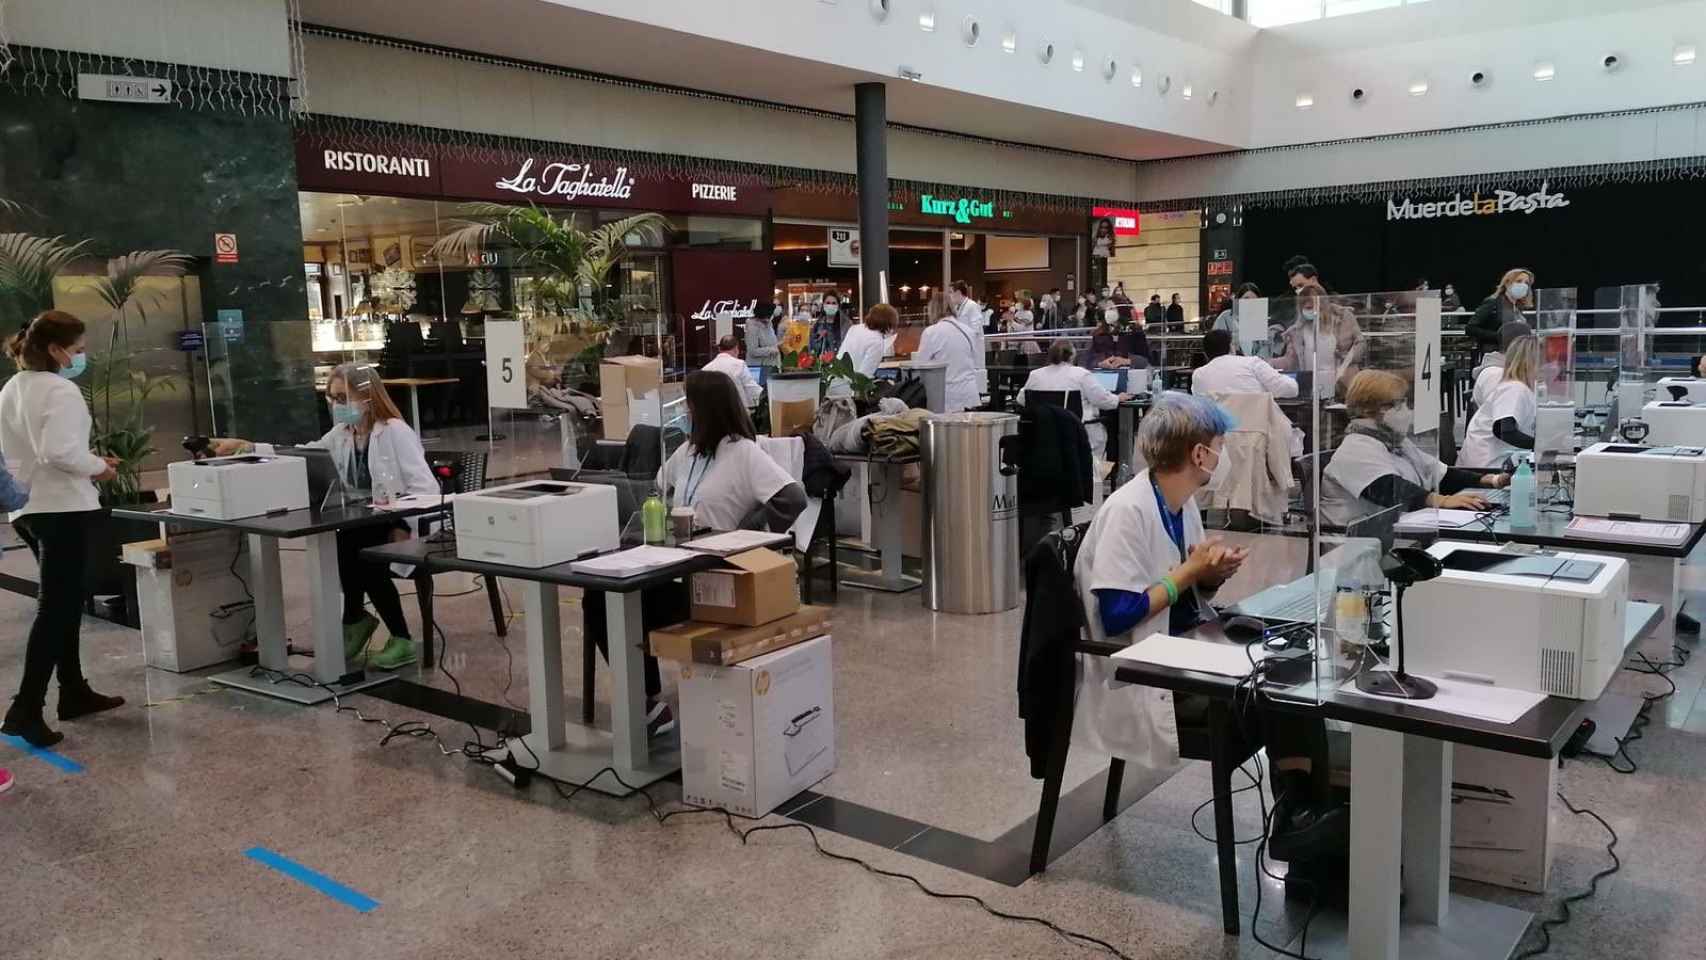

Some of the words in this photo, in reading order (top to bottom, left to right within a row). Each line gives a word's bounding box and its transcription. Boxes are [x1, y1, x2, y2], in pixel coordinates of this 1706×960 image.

[324, 149, 430, 177] RISTORANTI
[496, 158, 536, 193] La
[537, 162, 632, 200] Tagliatella
[692, 183, 736, 201] PIZZERIE
[691, 299, 712, 320] La
[502, 357, 512, 383] 5
[1421, 343, 1431, 391] 4
